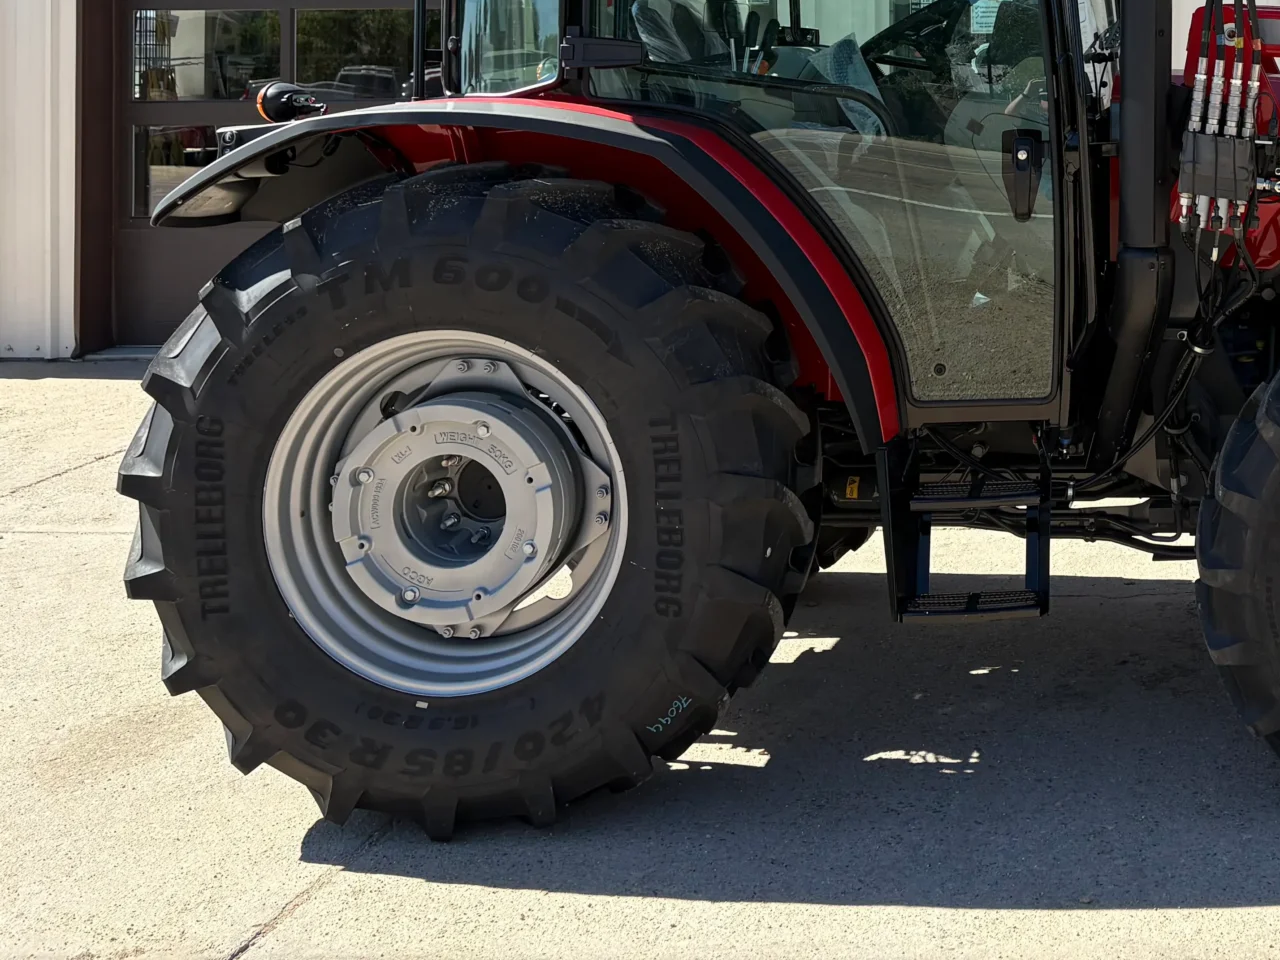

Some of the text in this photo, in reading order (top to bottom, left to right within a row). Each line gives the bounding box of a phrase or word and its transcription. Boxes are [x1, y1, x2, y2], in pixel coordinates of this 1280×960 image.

[432, 254, 551, 304] 600
[439, 431, 514, 470] WEIGHT 50KG
[194, 415, 230, 621] TRELLEBORG
[649, 411, 685, 618] TRELLEBORG
[401, 566, 434, 586] AGCO
[404, 695, 608, 776] 420/85
